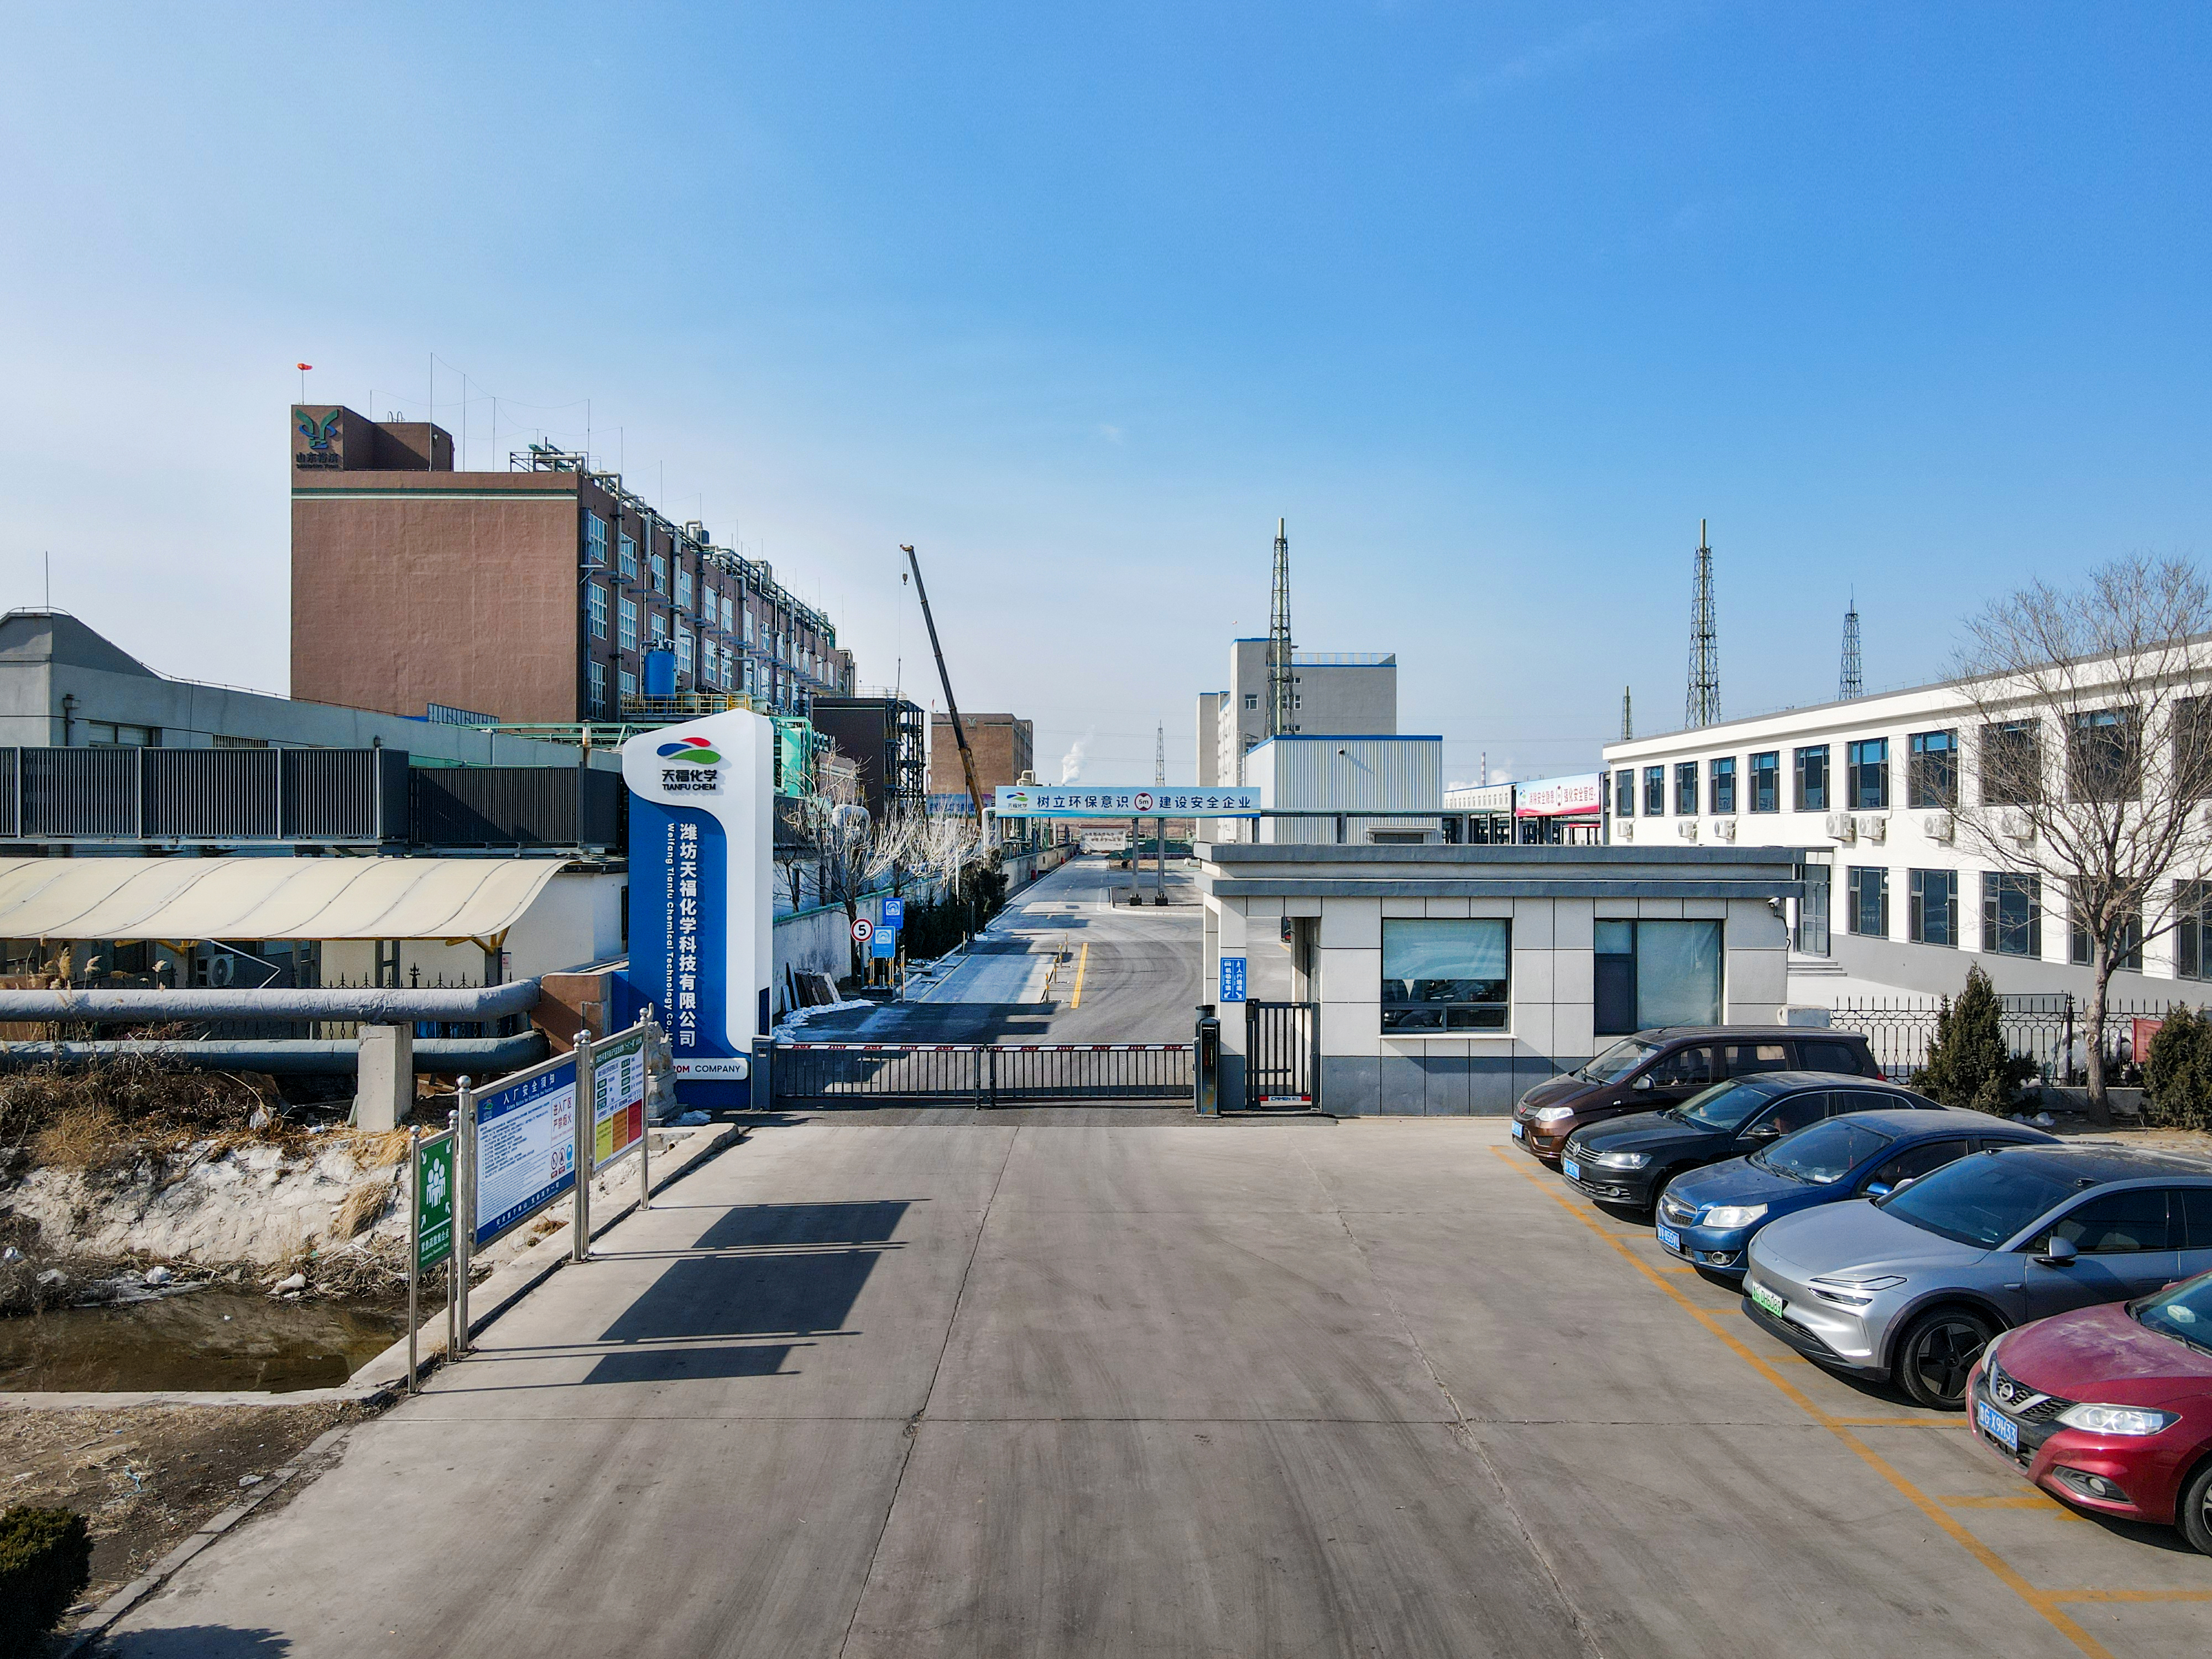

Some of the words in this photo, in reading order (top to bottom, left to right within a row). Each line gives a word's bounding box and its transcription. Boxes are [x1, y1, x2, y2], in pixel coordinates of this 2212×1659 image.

[662, 769, 717, 782] 天福化学
[1037, 795, 1129, 808] 树立环保意识
[1159, 795, 1251, 809] 建设安全企业
[665, 823, 675, 864] Weifang
[679, 823, 697, 1047] 潍坊天福化学科技有限公司
[858, 925, 867, 936] 5
[664, 952, 674, 1010] Technology
